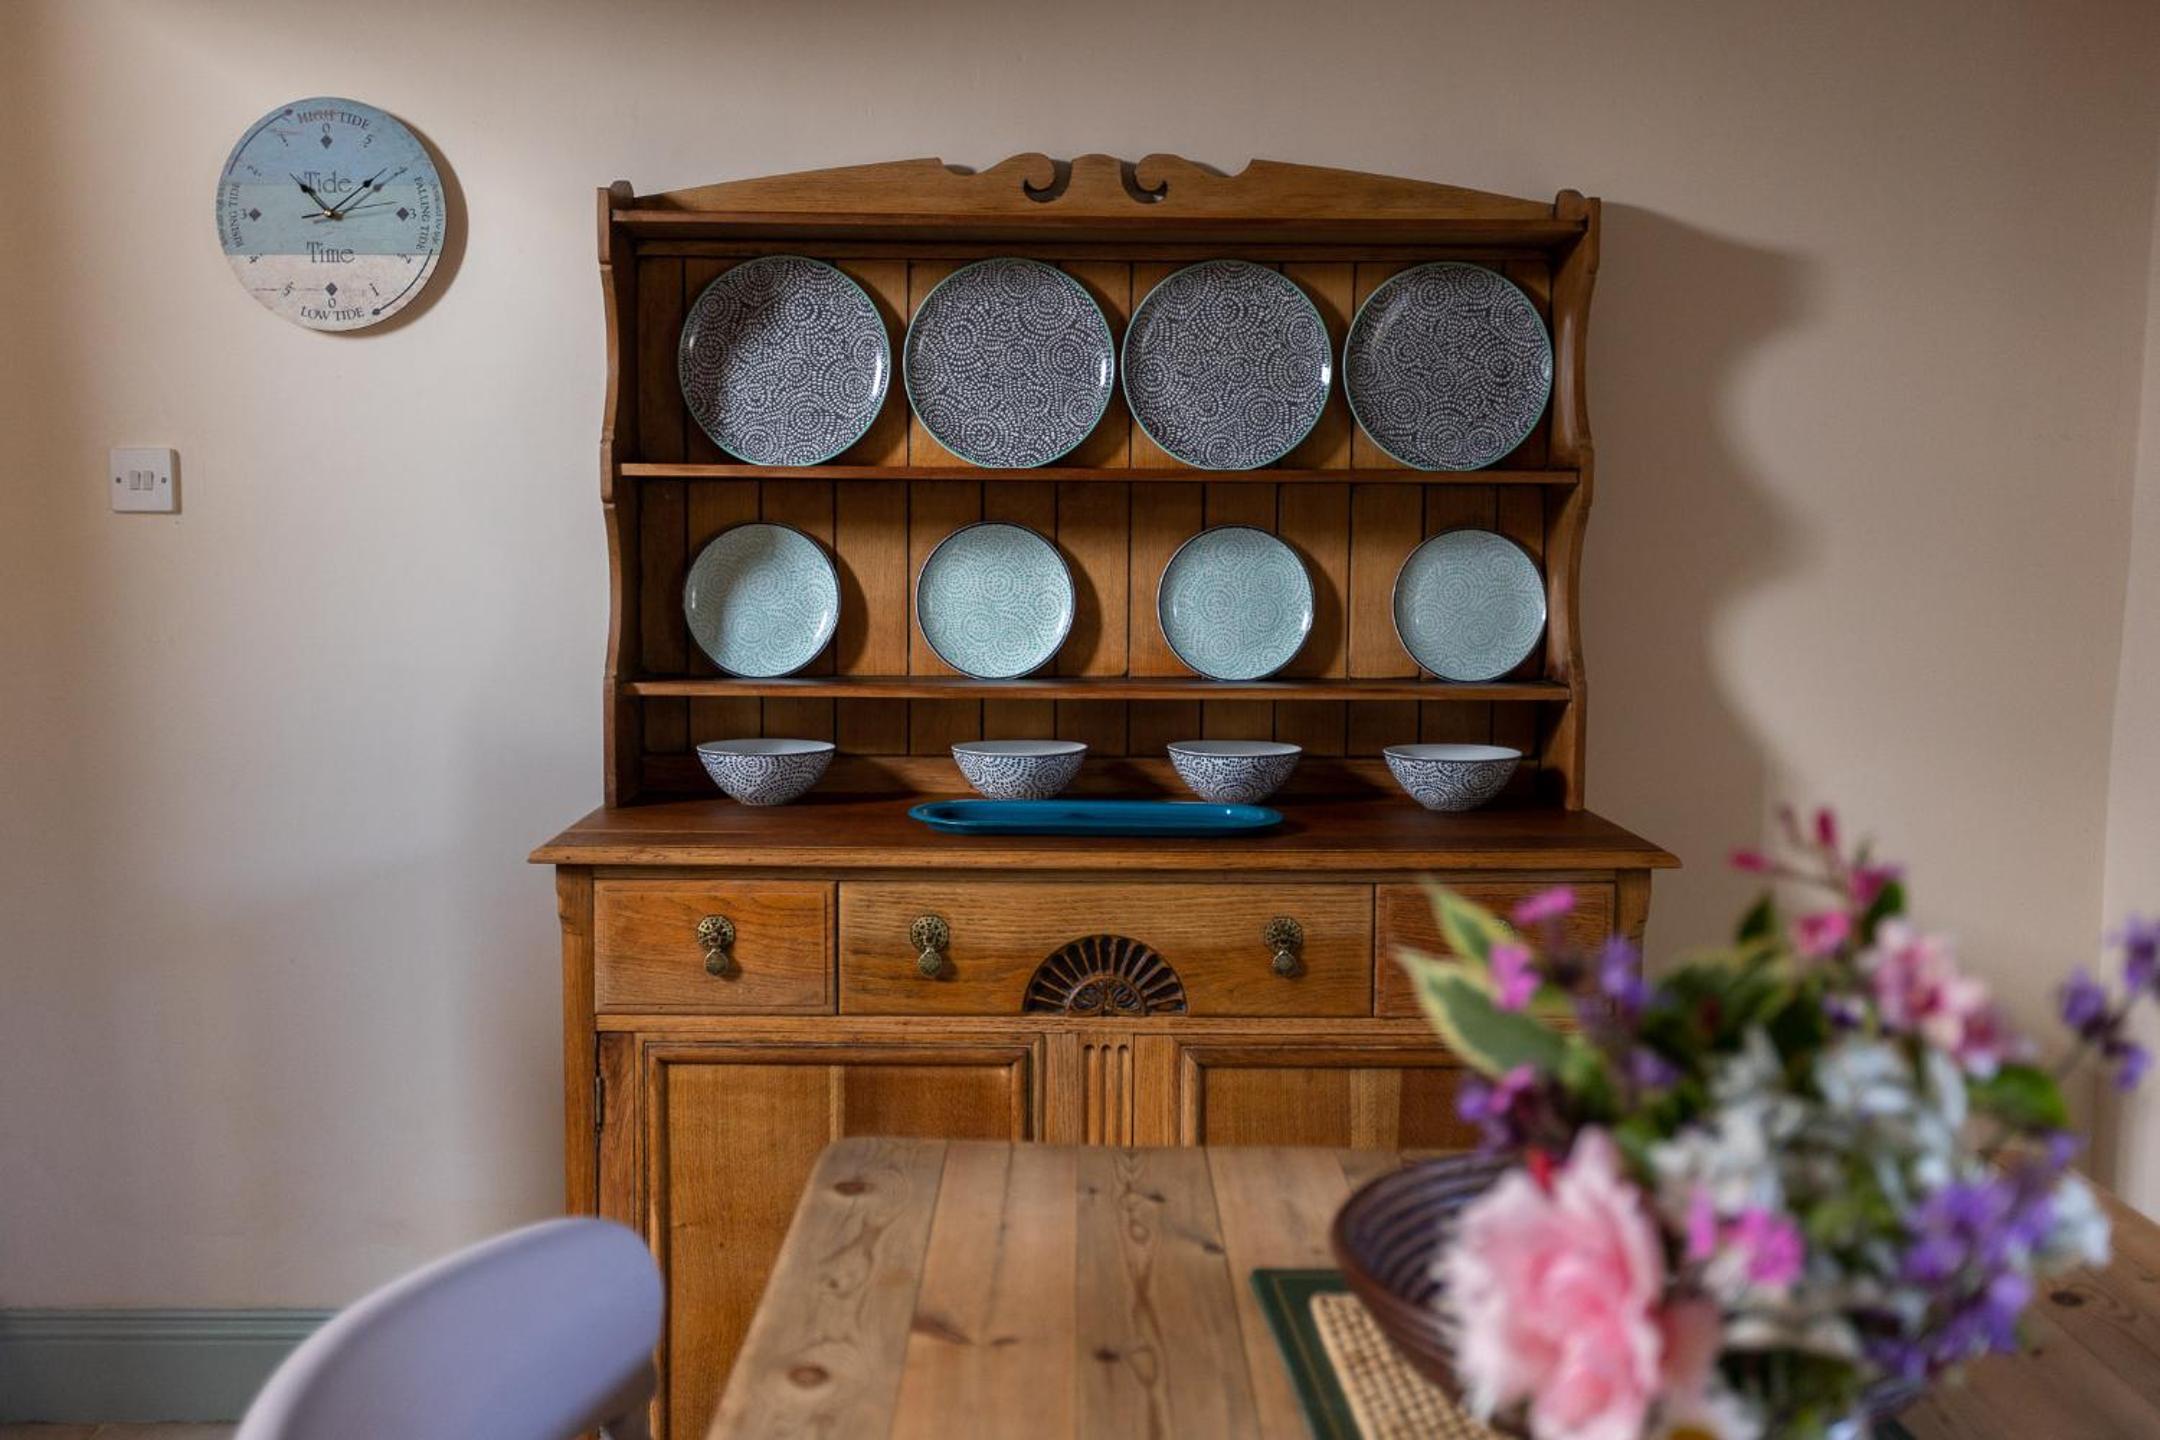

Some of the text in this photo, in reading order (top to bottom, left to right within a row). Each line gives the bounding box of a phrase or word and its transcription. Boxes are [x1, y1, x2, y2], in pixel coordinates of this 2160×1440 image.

[321, 122, 331, 134] 0
[337, 111, 369, 130] TIDE
[303, 170, 352, 193] Tide
[240, 208, 248, 220] 3
[409, 208, 417, 220] 3
[414, 176, 430, 250] FALLING TIDE
[306, 241, 355, 264] Time
[328, 297, 337, 309] 0
[300, 306, 365, 321] LOW TIDE
